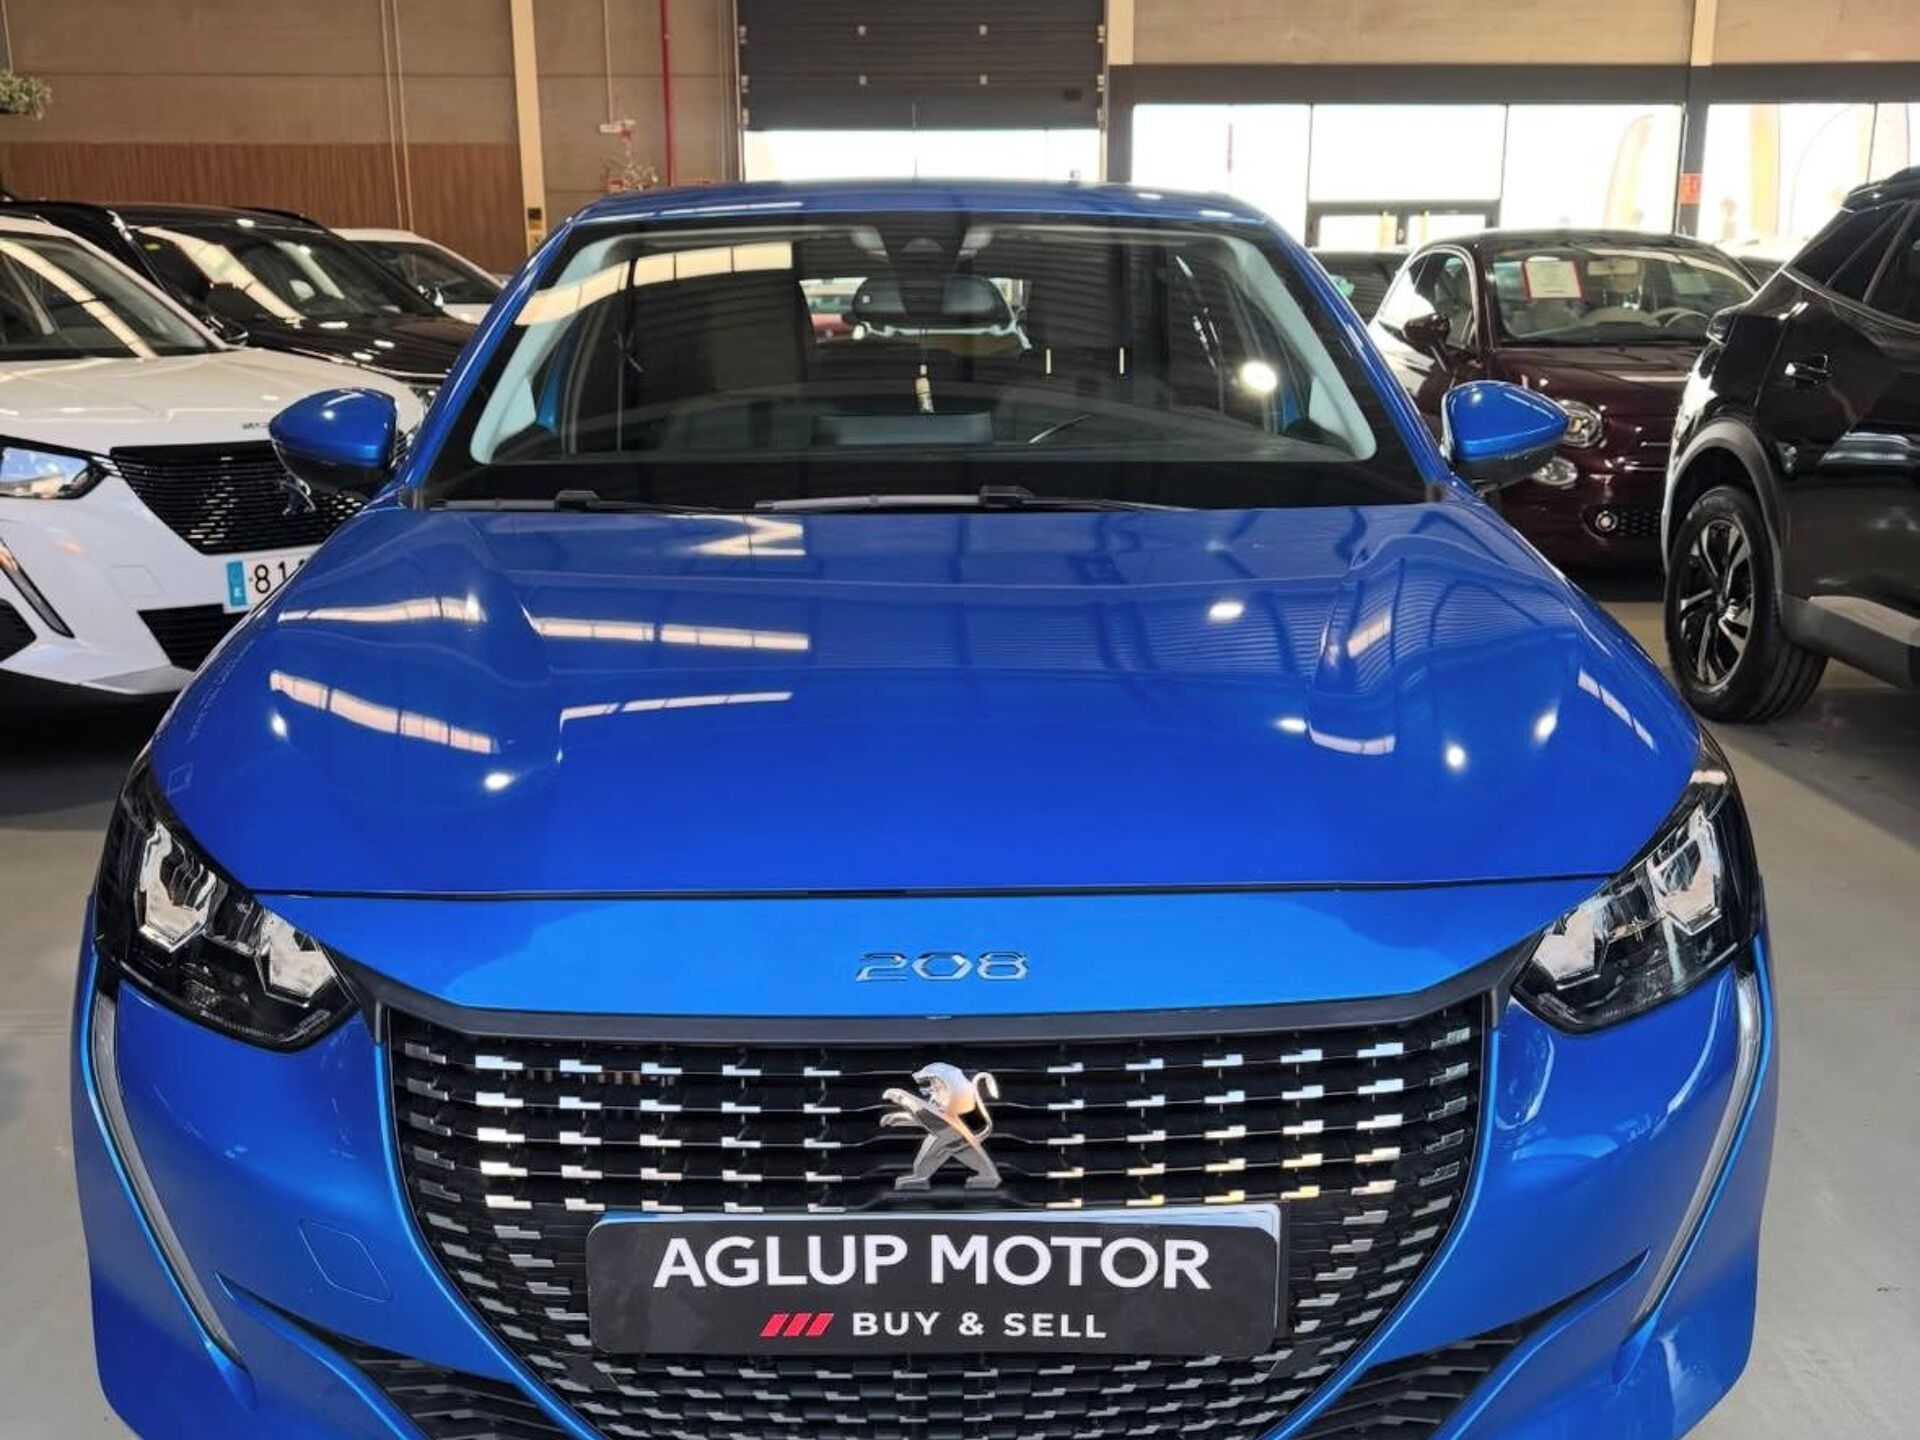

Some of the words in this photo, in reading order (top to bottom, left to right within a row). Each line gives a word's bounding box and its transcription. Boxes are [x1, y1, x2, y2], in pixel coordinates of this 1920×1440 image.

[254, 560, 304, 594] 81
[856, 951, 1028, 981] 208
[652, 1234, 908, 1288] AGLUP
[930, 1234, 1213, 1290] MOTOR
[852, 1311, 940, 1336] BUY
[958, 1311, 985, 1337] &
[1003, 1312, 1107, 1339] SELL
